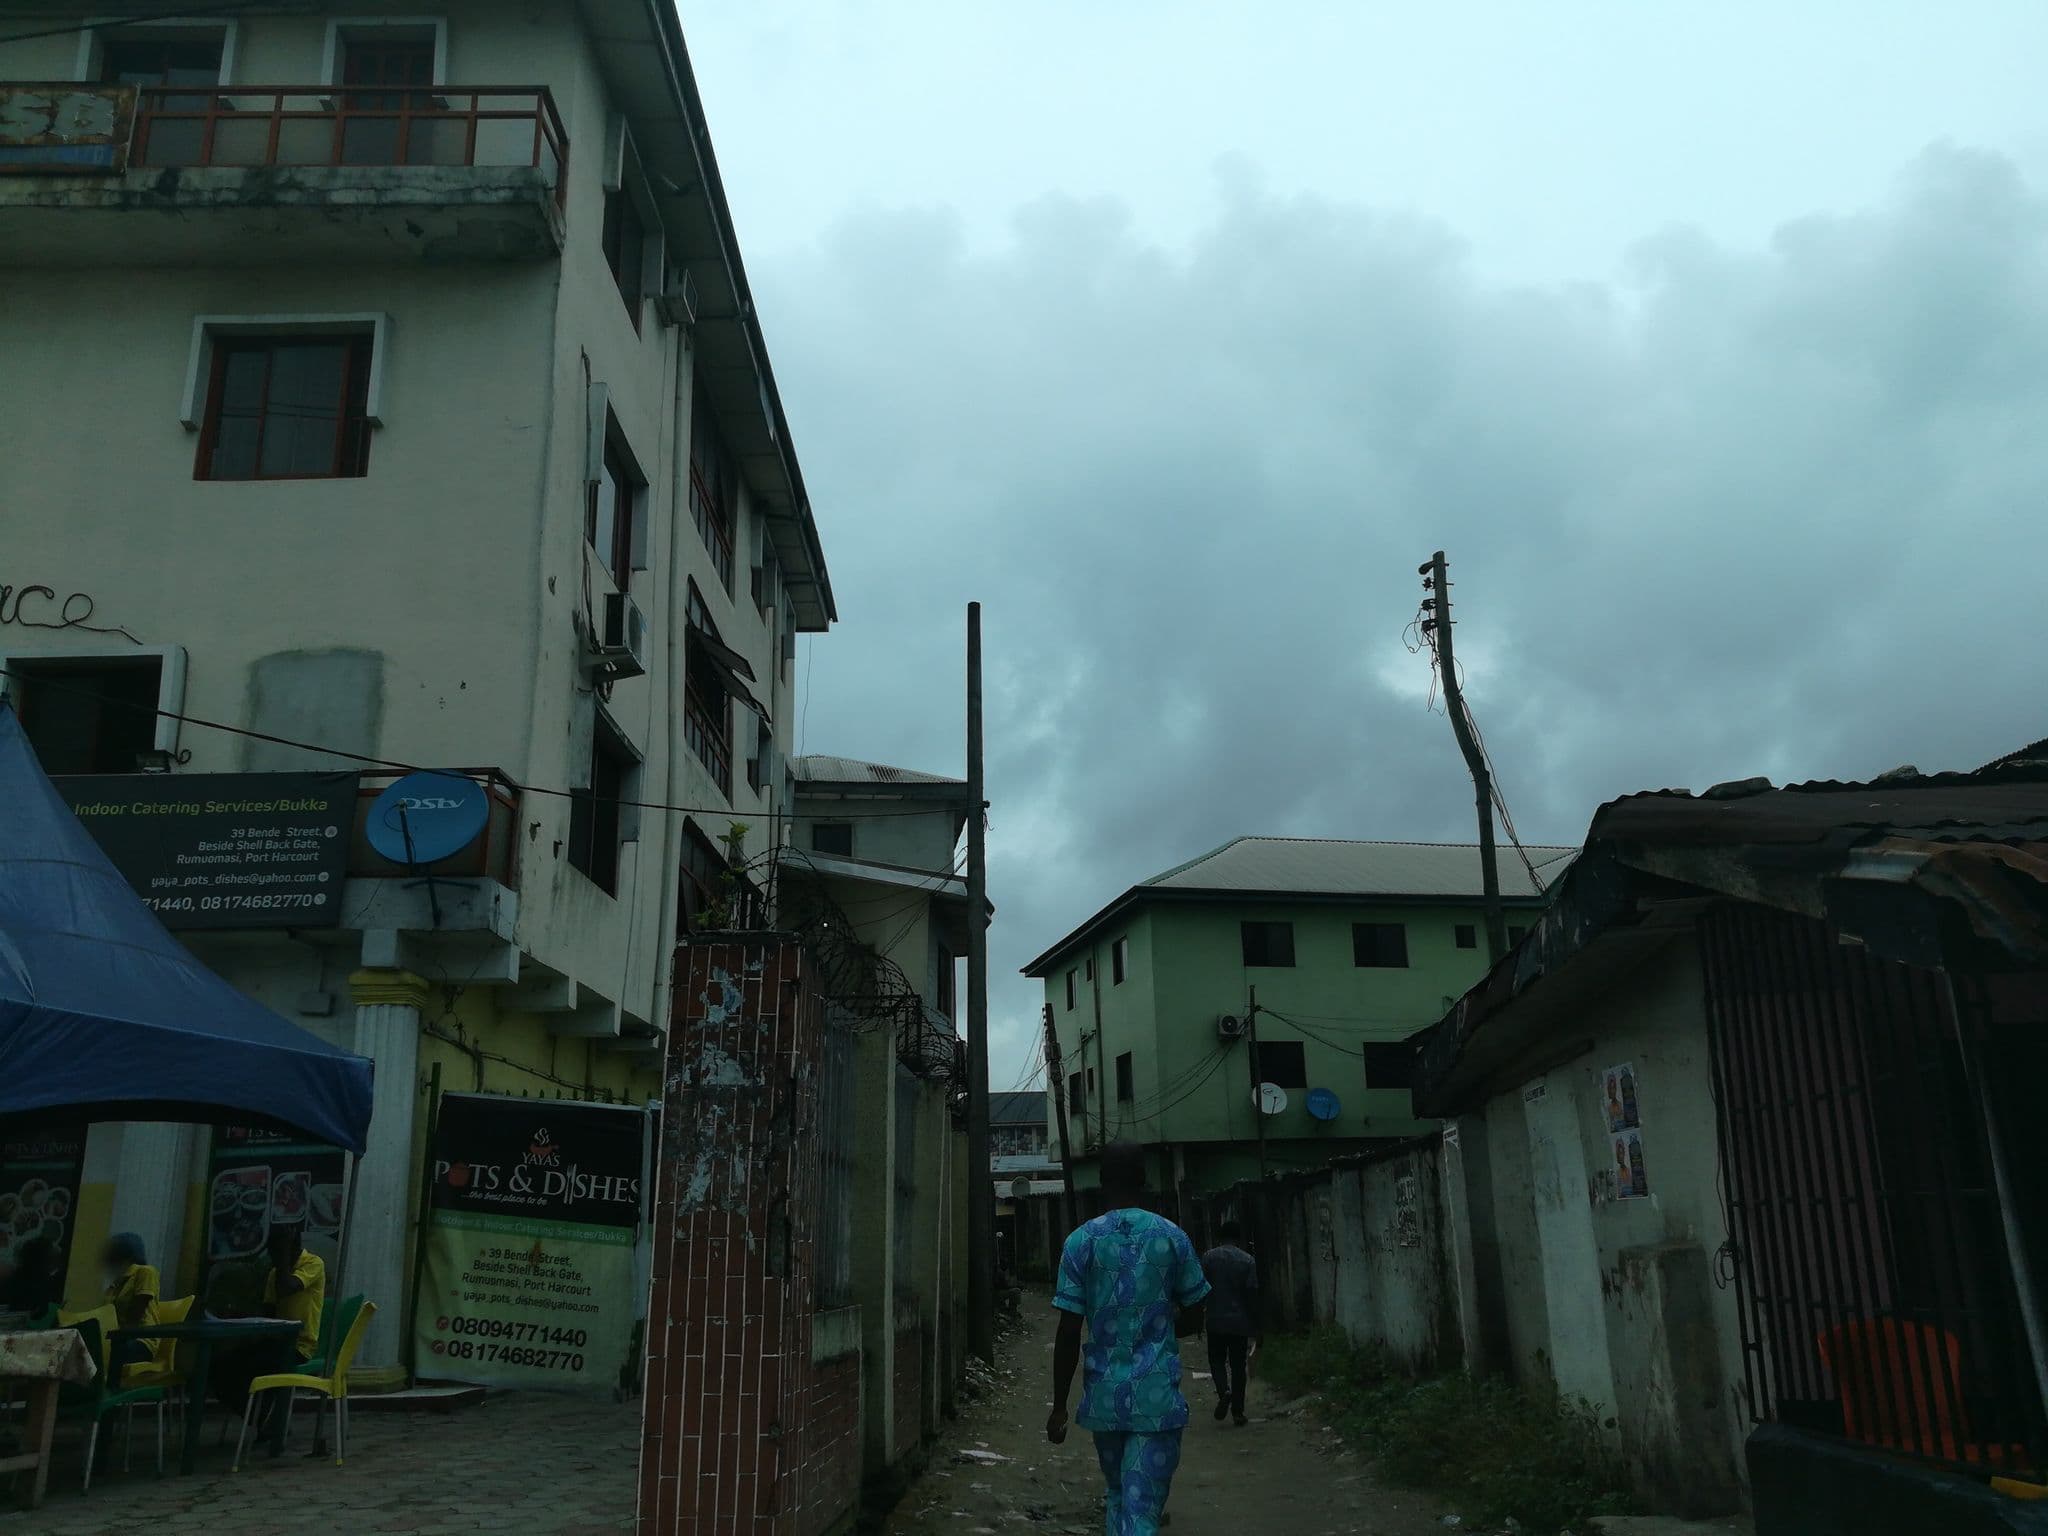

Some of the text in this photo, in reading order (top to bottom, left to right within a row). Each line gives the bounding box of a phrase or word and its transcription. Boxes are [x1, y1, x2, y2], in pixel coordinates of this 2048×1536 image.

[75, 799, 328, 816] Indoor Catering Services/Bukka
[231, 828, 245, 838] 39
[247, 827, 280, 838] Bende
[198, 839, 320, 851] Beside Shell Back Gate,
[245, 852, 269, 862] Port
[271, 851, 320, 862] Harcourt
[200, 893, 313, 911] 08174682770
[508, 1164, 535, 1194] &
[489, 1248, 502, 1259] 39
[540, 1254, 572, 1267] Street,
[473, 1259, 505, 1271] Beside
[533, 1265, 556, 1278] Back
[559, 1268, 583, 1283] Gate,
[524, 1279, 545, 1291] Port
[547, 1282, 592, 1297] Harcourt
[451, 1316, 587, 1347] 08094771440
[447, 1340, 584, 1371] 08174682770
